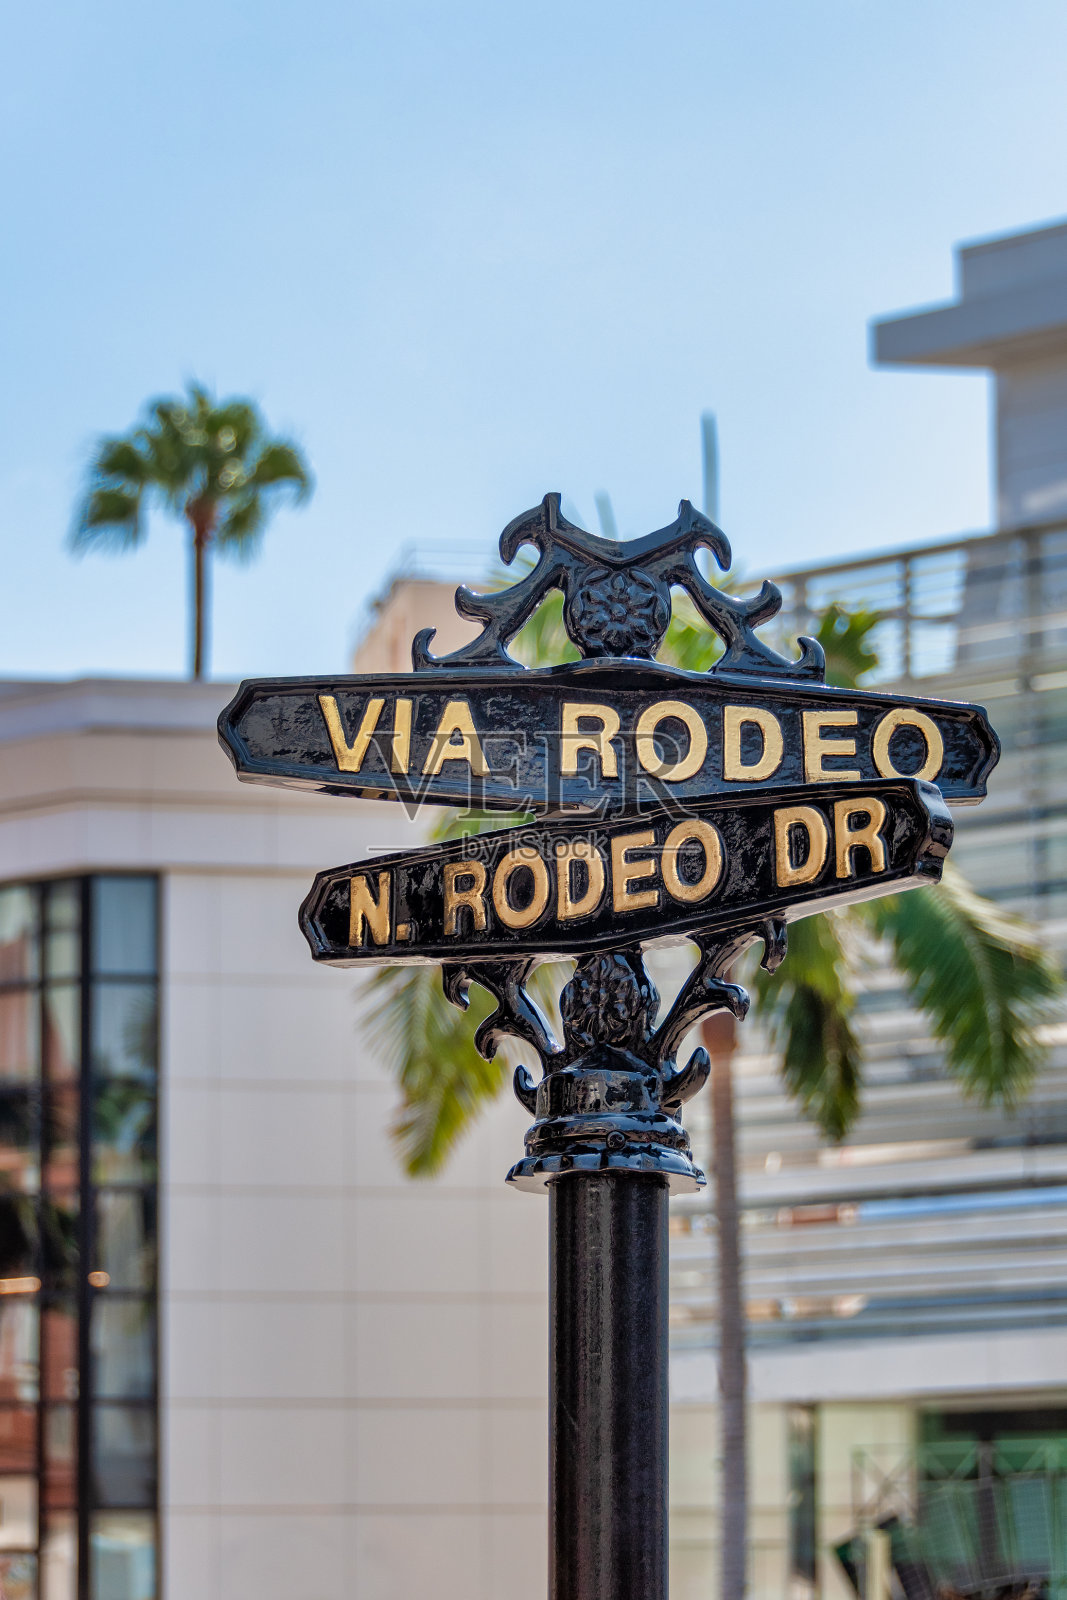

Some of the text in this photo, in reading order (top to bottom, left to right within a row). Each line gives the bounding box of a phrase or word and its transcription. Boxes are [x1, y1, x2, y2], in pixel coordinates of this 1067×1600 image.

[318, 695, 944, 784] VIA RODEO
[348, 797, 887, 947] N. RODEO DR
